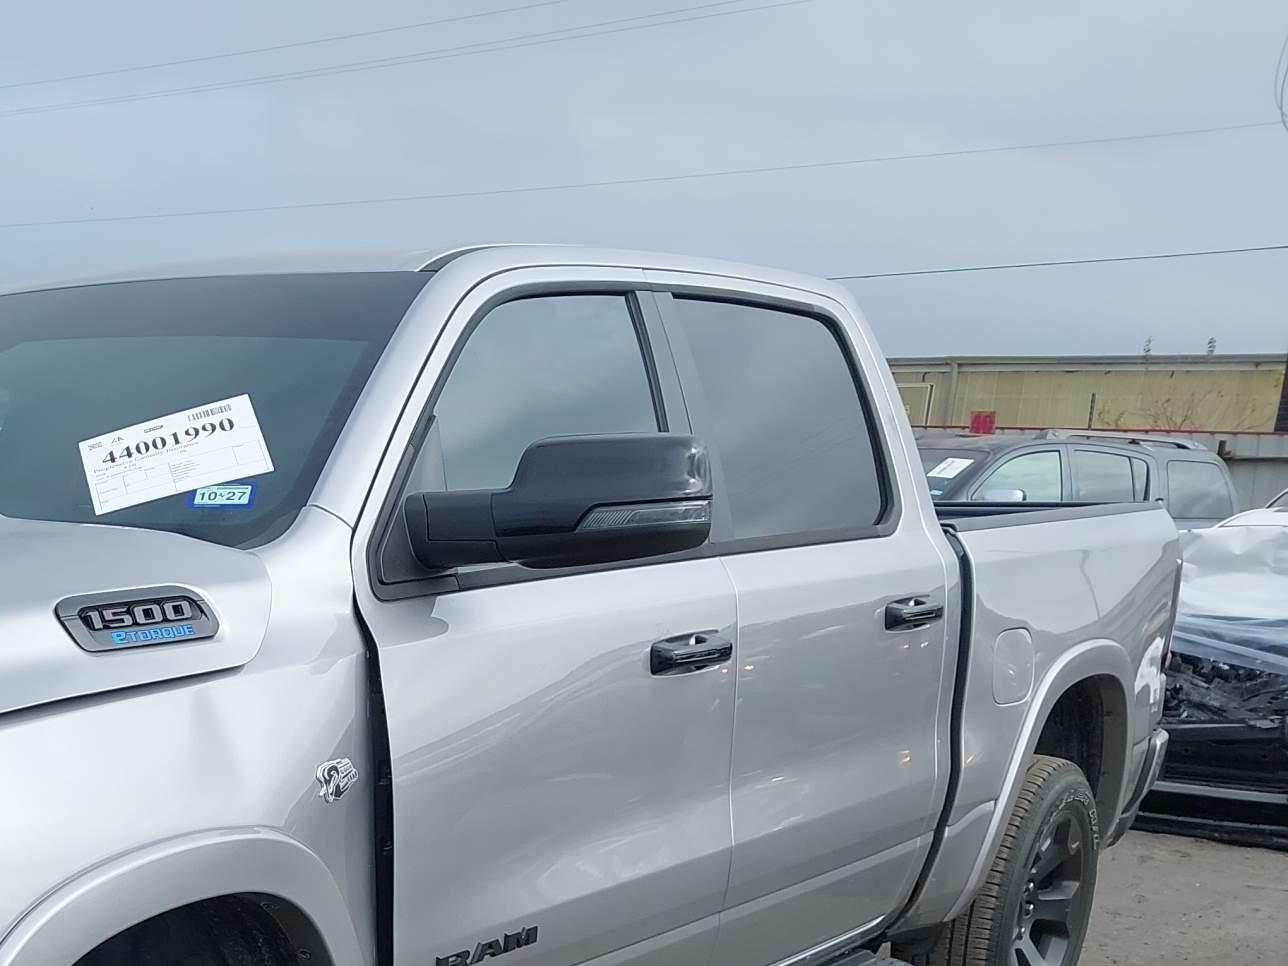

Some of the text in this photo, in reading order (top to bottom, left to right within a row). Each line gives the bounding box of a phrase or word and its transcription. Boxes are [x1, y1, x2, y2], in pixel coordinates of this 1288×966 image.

[102, 417, 235, 464] 44001990
[199, 491, 247, 501] 10 27
[82, 599, 193, 631] 1500
